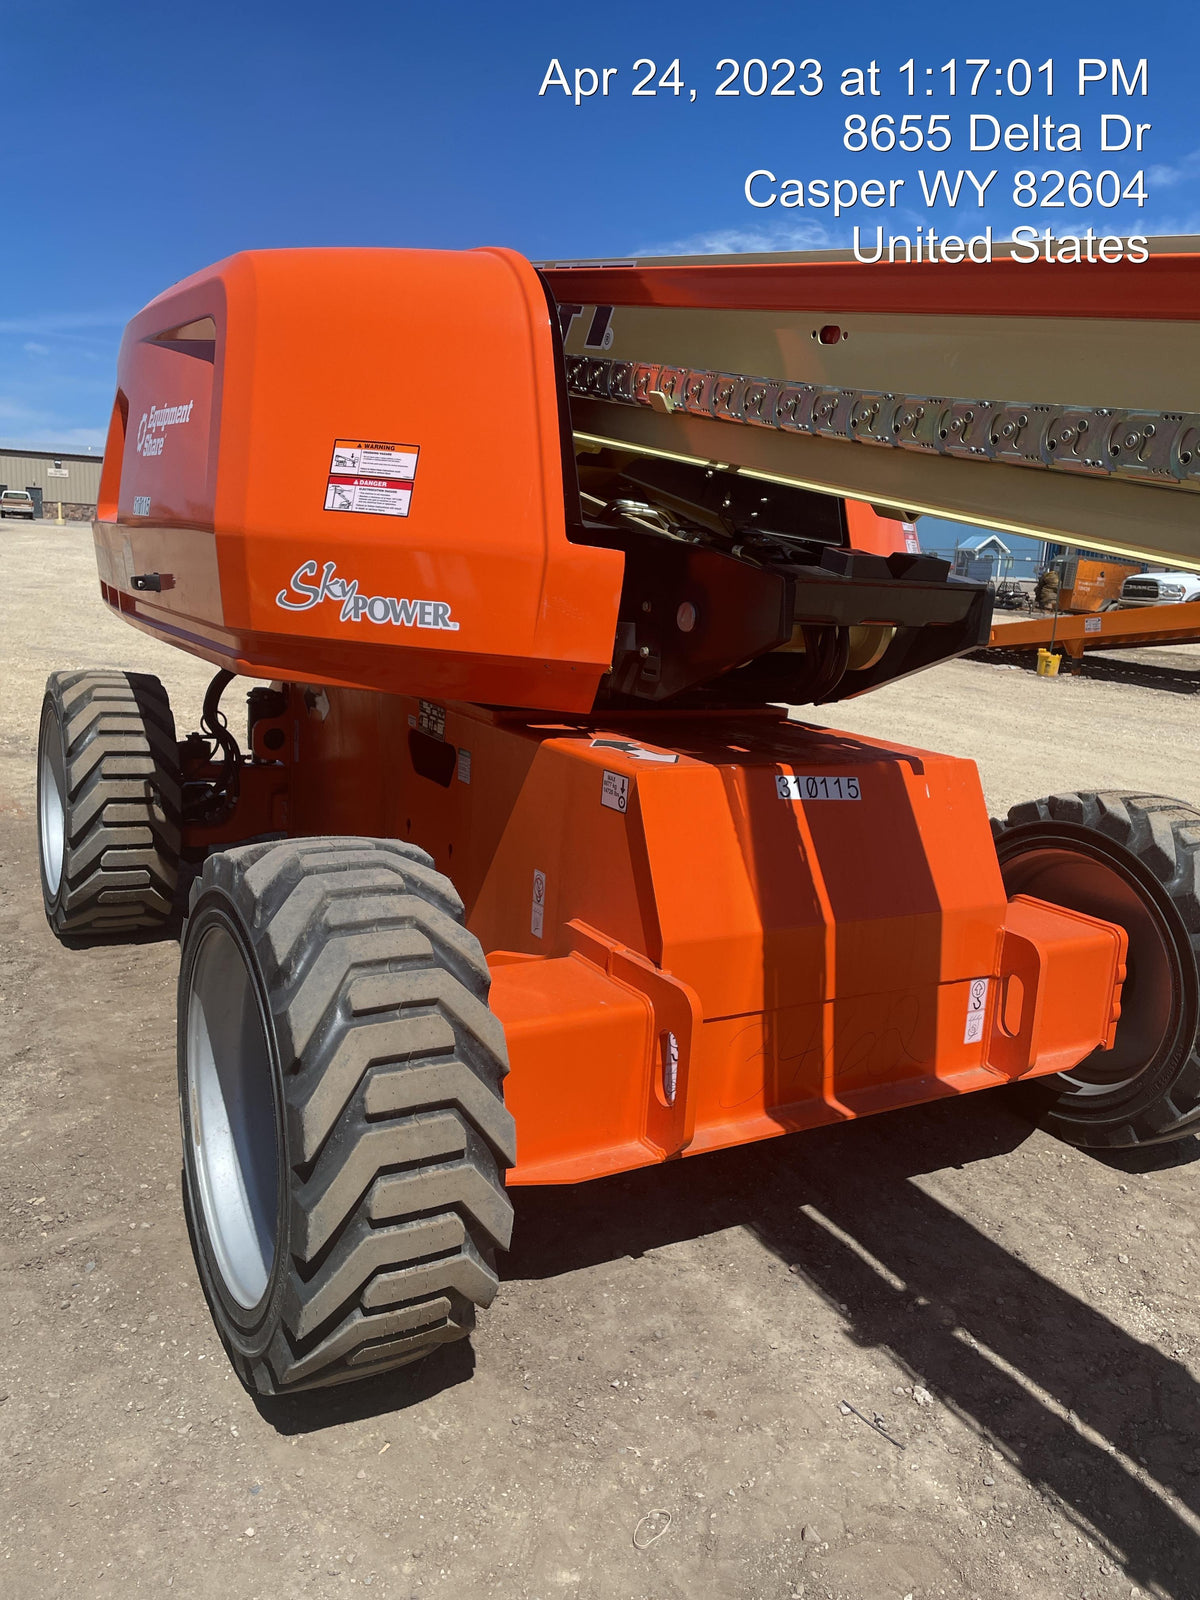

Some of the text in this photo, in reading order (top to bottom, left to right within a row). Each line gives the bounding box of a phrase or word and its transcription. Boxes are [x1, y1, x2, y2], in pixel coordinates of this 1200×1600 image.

[147, 399, 194, 433] Equipment
[142, 433, 165, 457] Share
[364, 443, 396, 451] WARNING
[276, 559, 454, 630] Sky POWER
[778, 776, 859, 799] 310115
